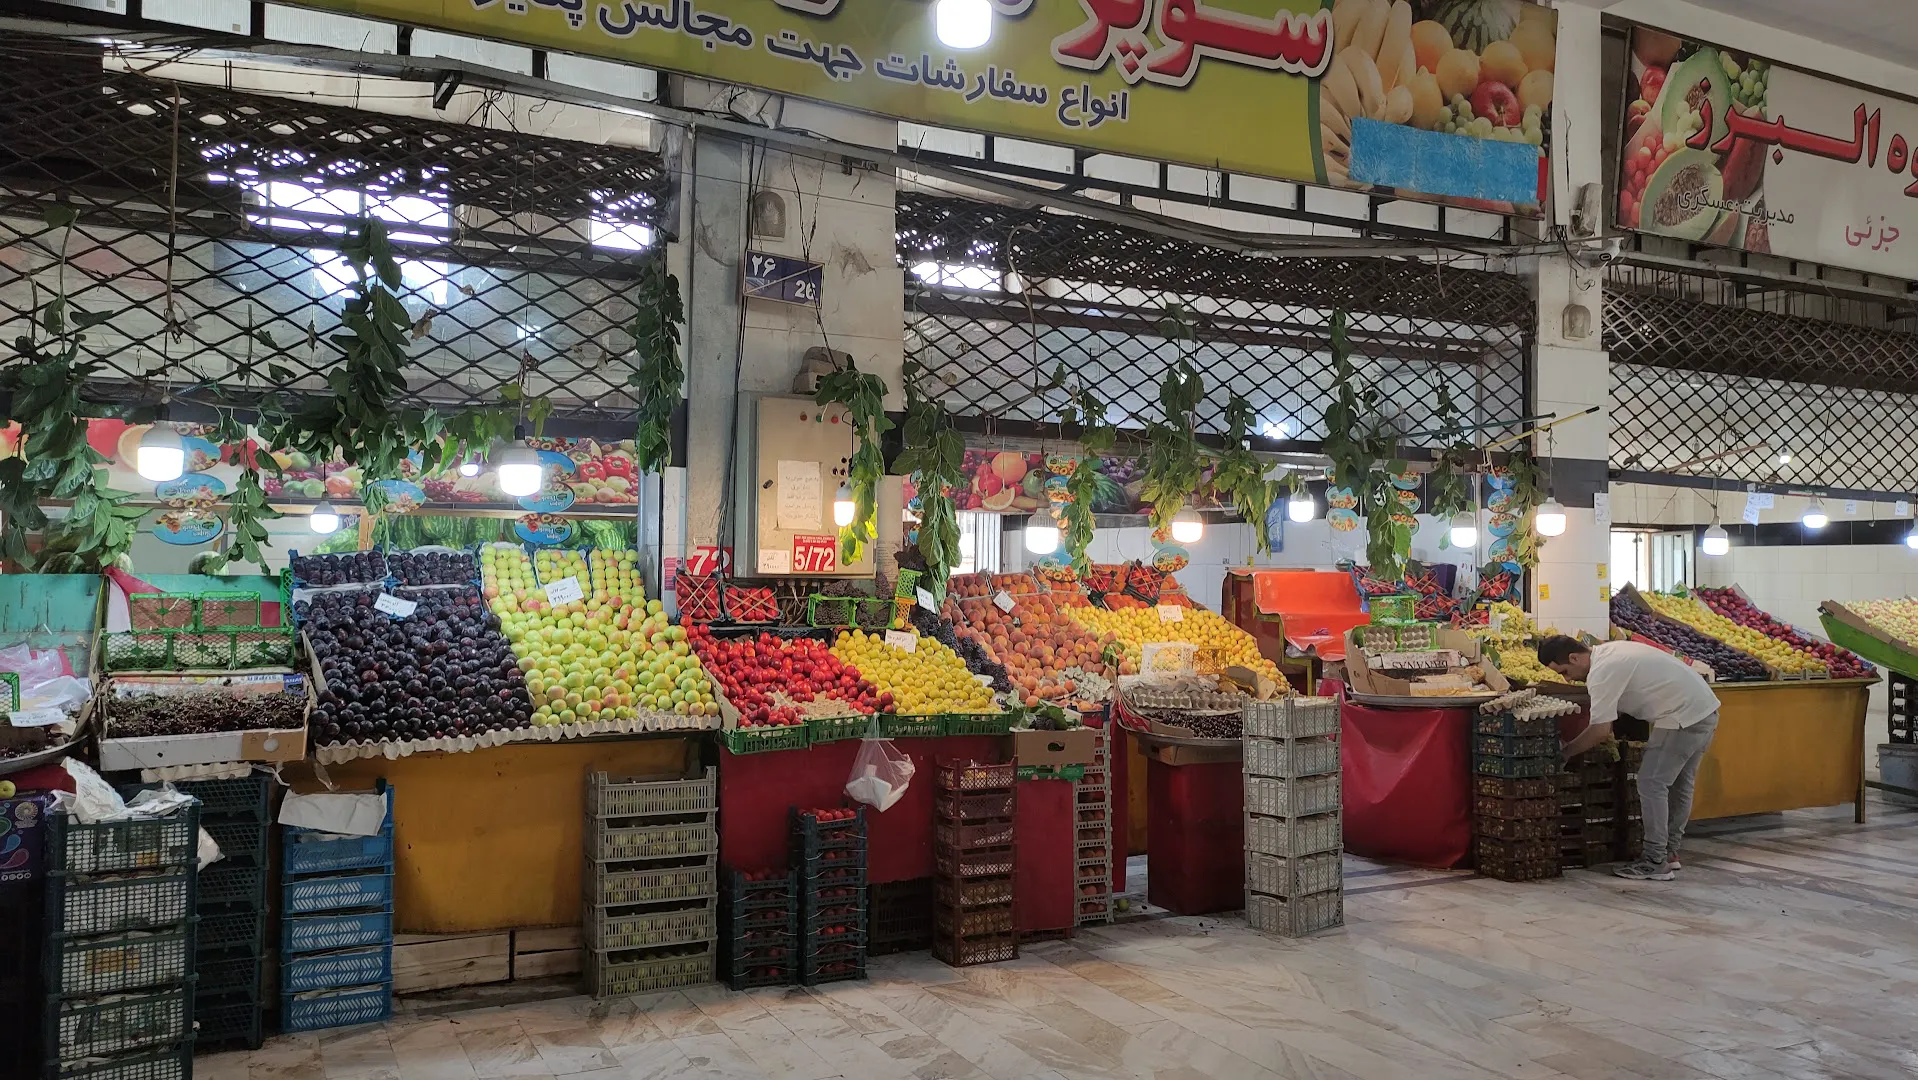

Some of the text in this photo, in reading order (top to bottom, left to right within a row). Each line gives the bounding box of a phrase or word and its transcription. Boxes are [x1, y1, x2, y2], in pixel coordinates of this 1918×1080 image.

[600, 0, 752, 49] مجالس
[766, 30, 863, 79] جهت
[877, 54, 1047, 104] سفارشات
[1058, 89, 1128, 126] انواع
[1685, 76, 1881, 168] البرز
[1845, 215, 1900, 252] جزئی
[752, 255, 776, 278] ۲۶
[794, 280, 816, 300] 26
[794, 546, 835, 572] 5/72
